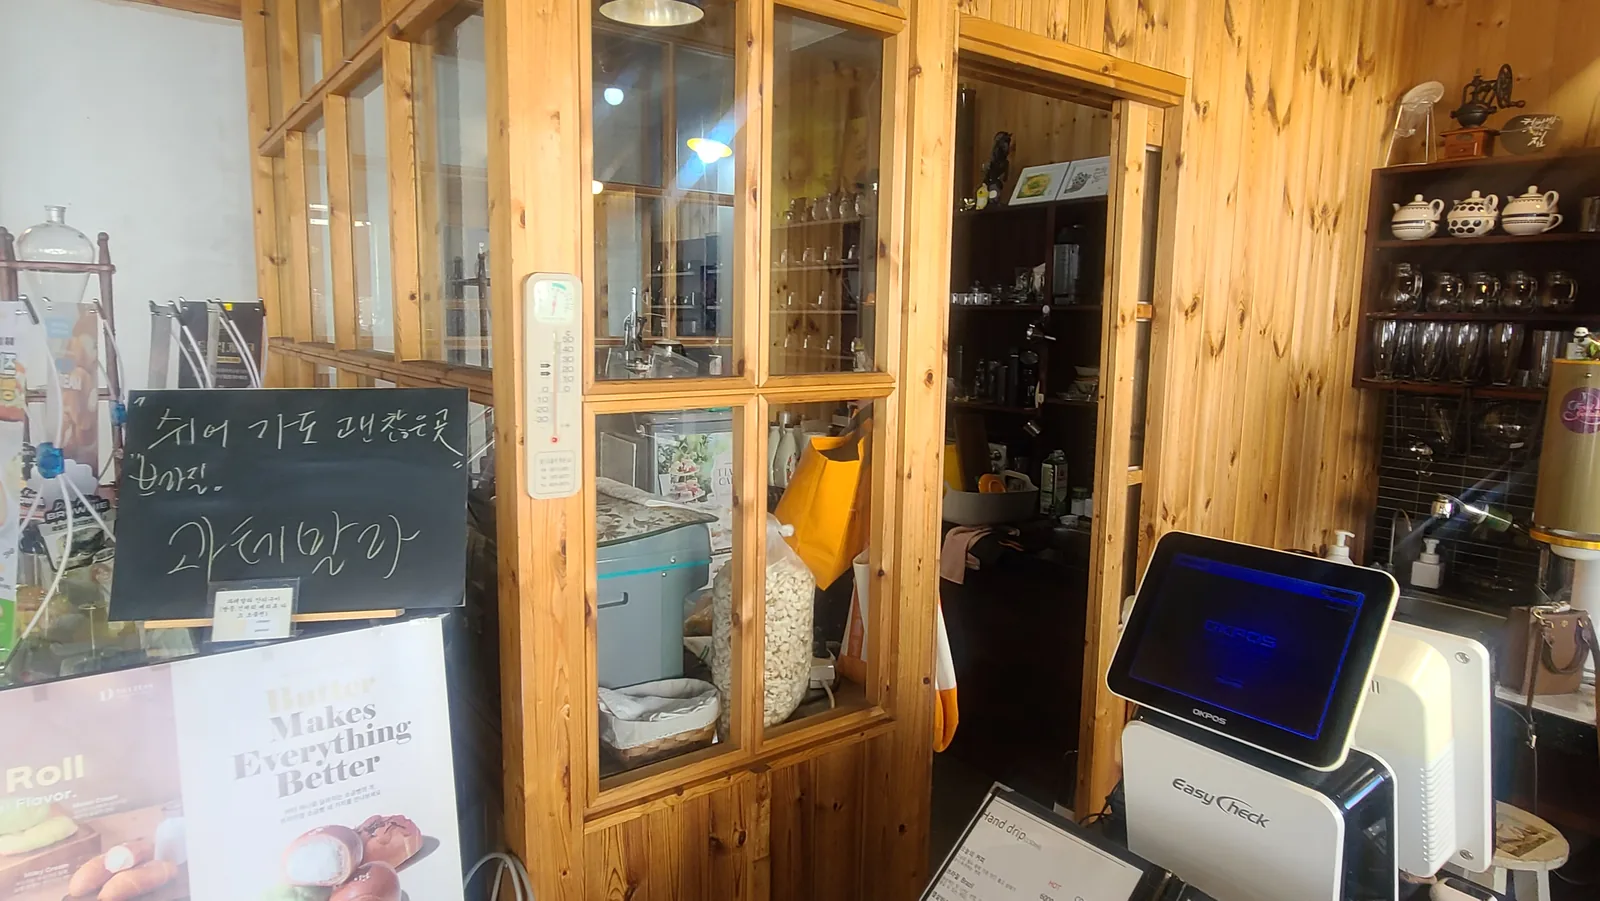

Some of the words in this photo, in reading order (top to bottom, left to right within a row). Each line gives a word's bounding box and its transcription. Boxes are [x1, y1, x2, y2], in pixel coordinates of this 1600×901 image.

[248, 410, 317, 449] 가도
[167, 510, 421, 582] 과테말라
[264, 676, 376, 713] Butter
[268, 703, 376, 743] Makes
[1192, 708, 1227, 725] OKPOS
[232, 719, 412, 781] Everything
[6, 754, 84, 793] Roll
[277, 754, 381, 800] Better
[16, 789, 77, 809] Flavor.
[982, 811, 1007, 829] Hand
[1006, 824, 1027, 841] drip
